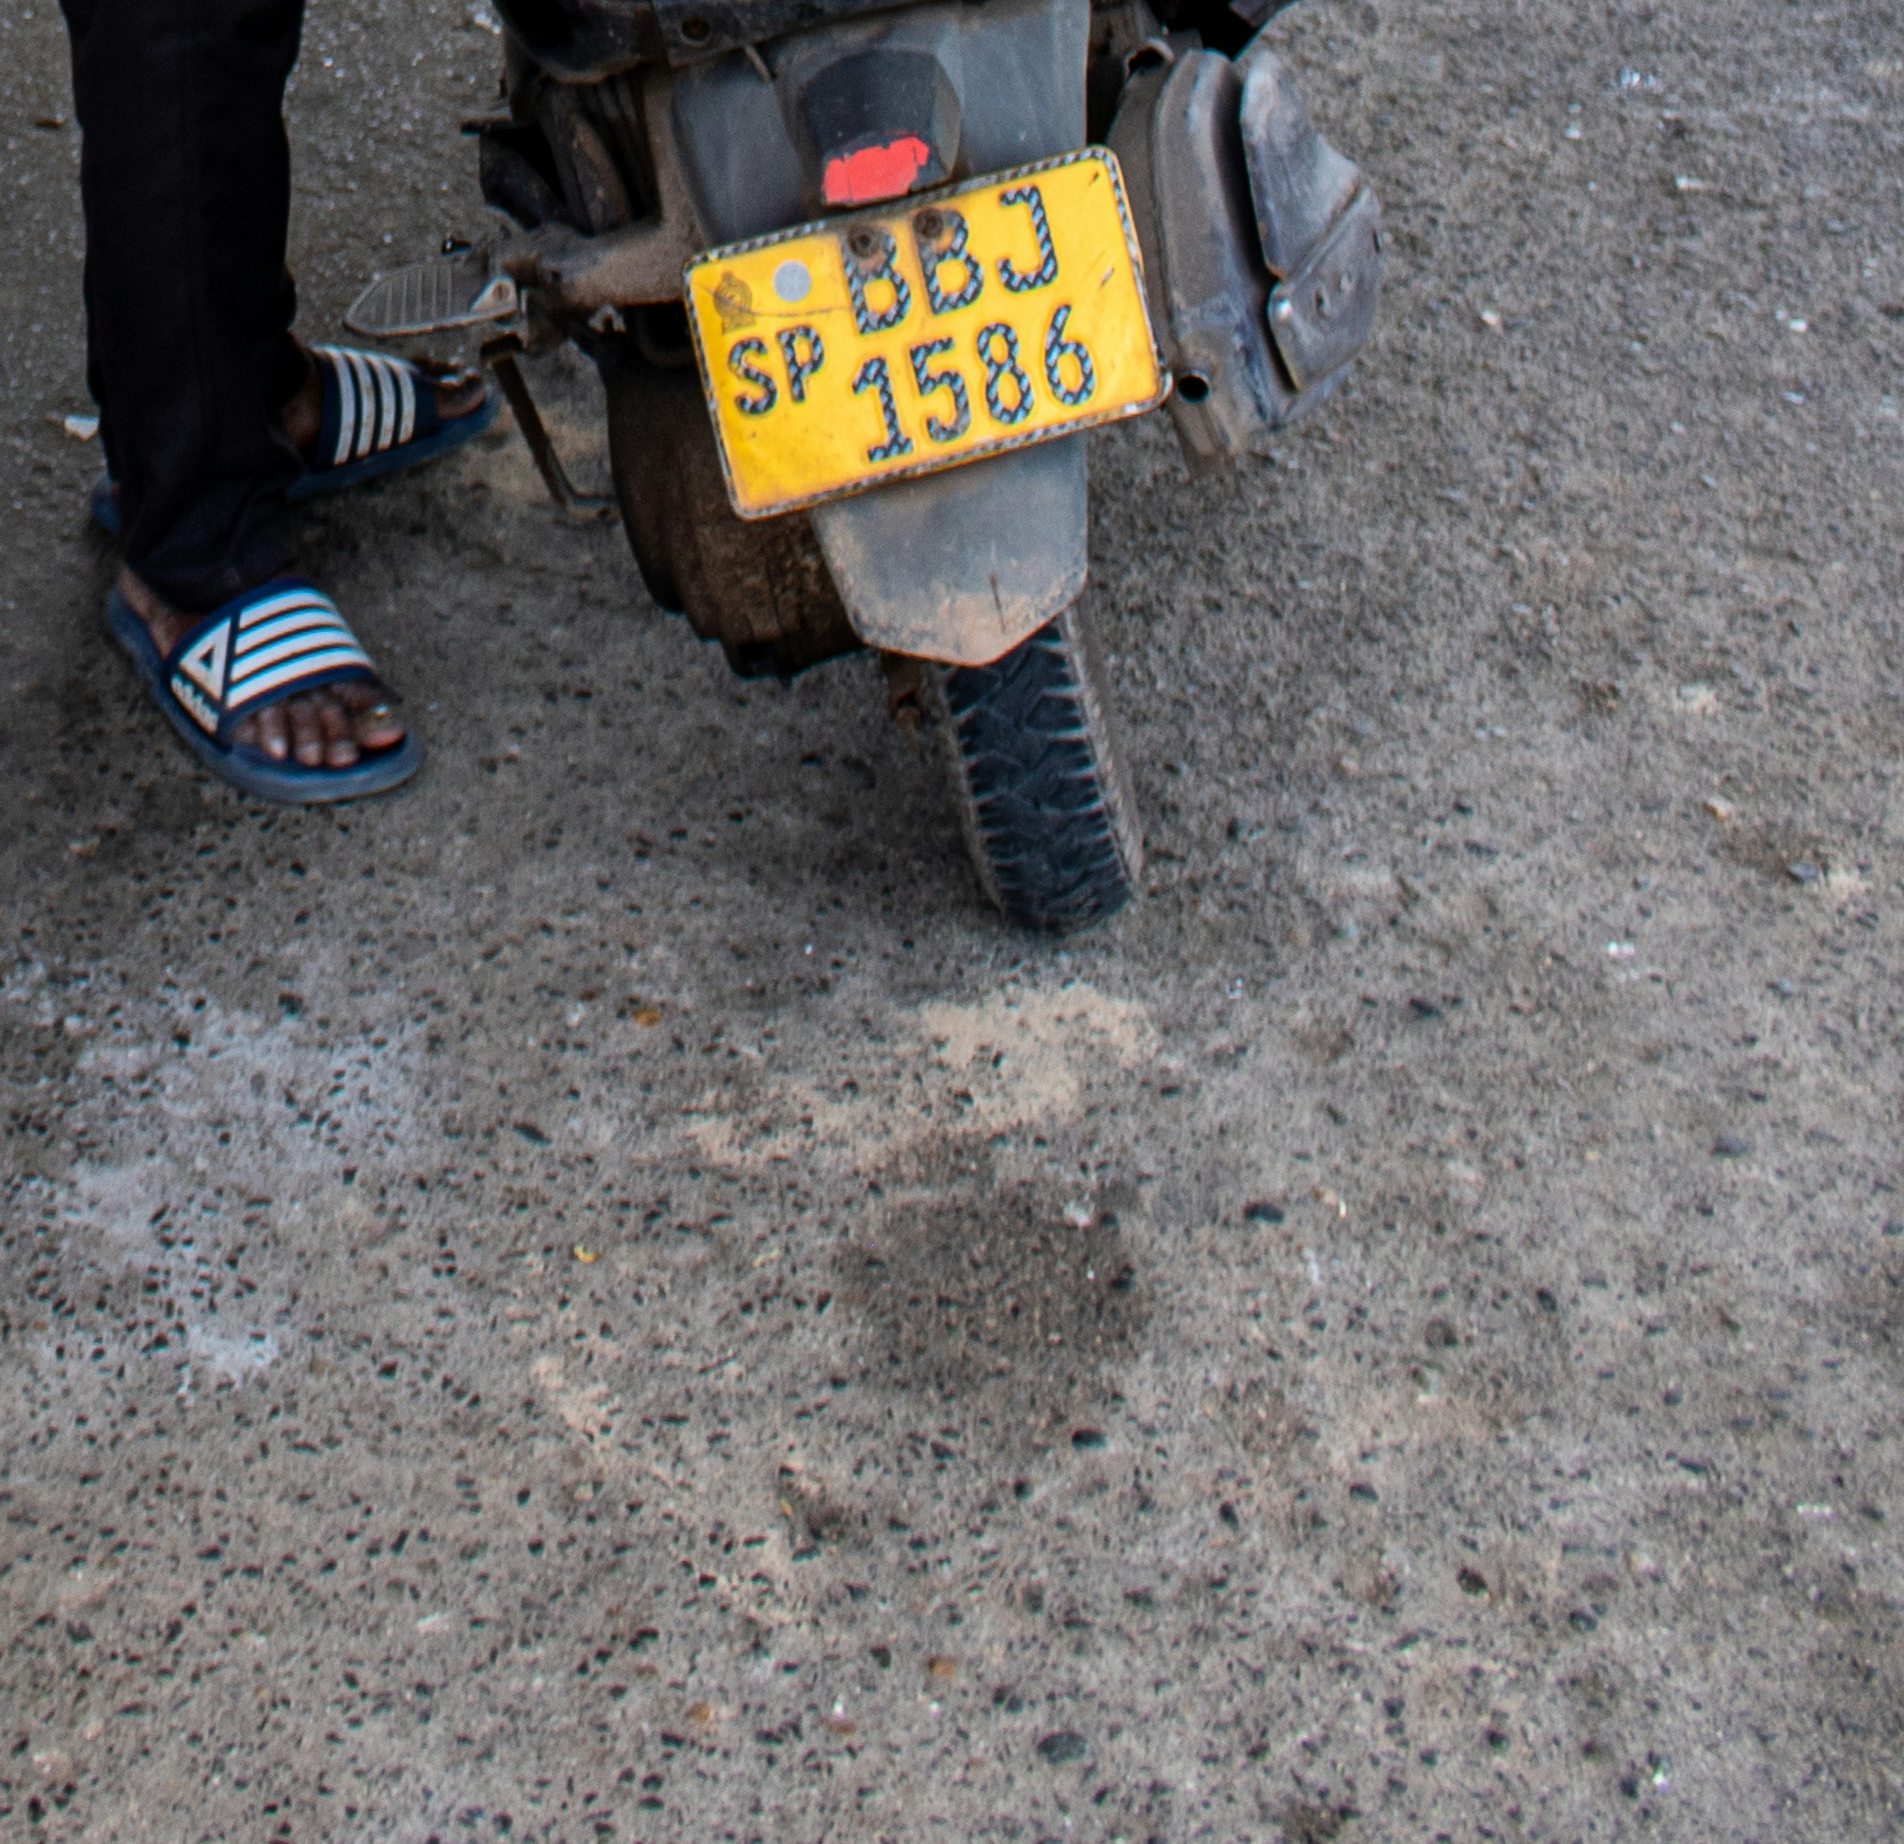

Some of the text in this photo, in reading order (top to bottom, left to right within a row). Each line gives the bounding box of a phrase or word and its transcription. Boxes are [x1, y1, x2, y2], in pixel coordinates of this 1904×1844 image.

[840, 184, 1059, 336] BBJ
[728, 324, 824, 416] SP
[851, 304, 1096, 463] 1586
